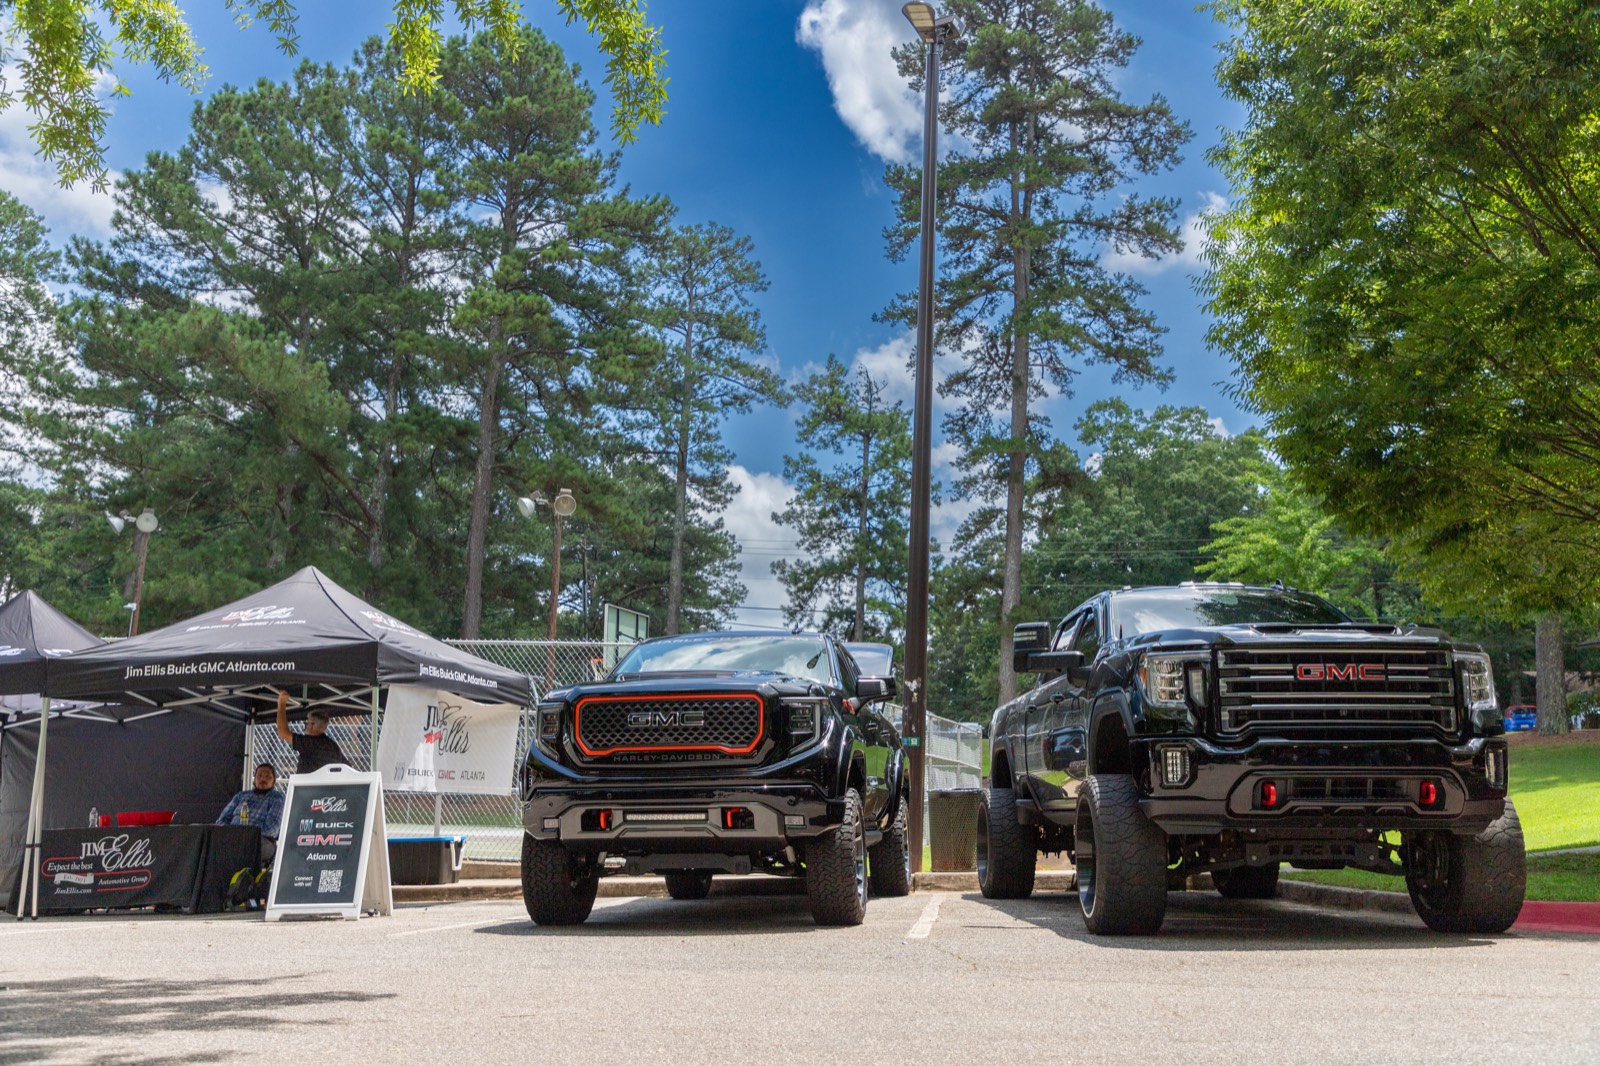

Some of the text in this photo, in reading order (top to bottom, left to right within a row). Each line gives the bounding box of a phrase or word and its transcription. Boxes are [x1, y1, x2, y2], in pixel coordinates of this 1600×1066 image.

[1296, 663, 1386, 681] GMC
[627, 711, 705, 728] GMC
[613, 753, 721, 762] HARLEY-DAVIDSON
[438, 769, 456, 780] GMC
[460, 770, 486, 781] ATLANTA
[320, 796, 349, 813] Ellis
[297, 834, 353, 845] GMC
[80, 833, 157, 872] JIM Ellis
[306, 853, 337, 861] Atlanta
[47, 862, 93, 872] Expect the best
[98, 875, 149, 886] Automotive Group
[54, 886, 92, 895] JimEllis.com
